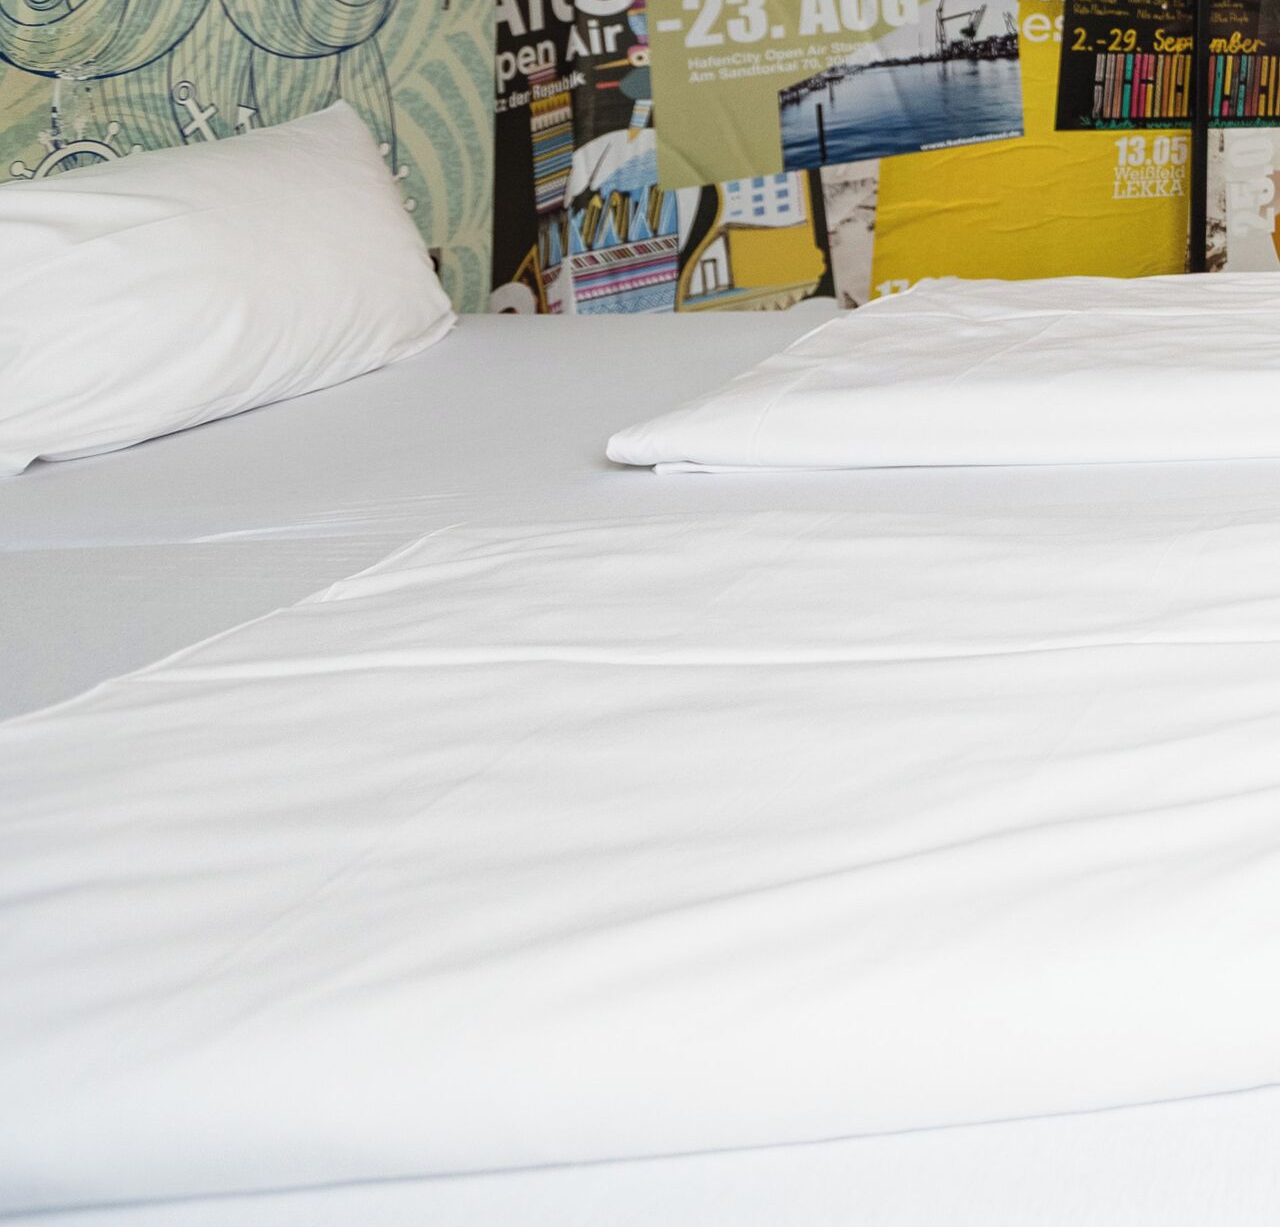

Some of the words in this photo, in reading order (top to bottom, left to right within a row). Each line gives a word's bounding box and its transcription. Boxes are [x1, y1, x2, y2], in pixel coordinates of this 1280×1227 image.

[565, 19, 624, 62] Air
[1114, 135, 1188, 166] 13.05
[1112, 178, 1186, 200] LEKKA
